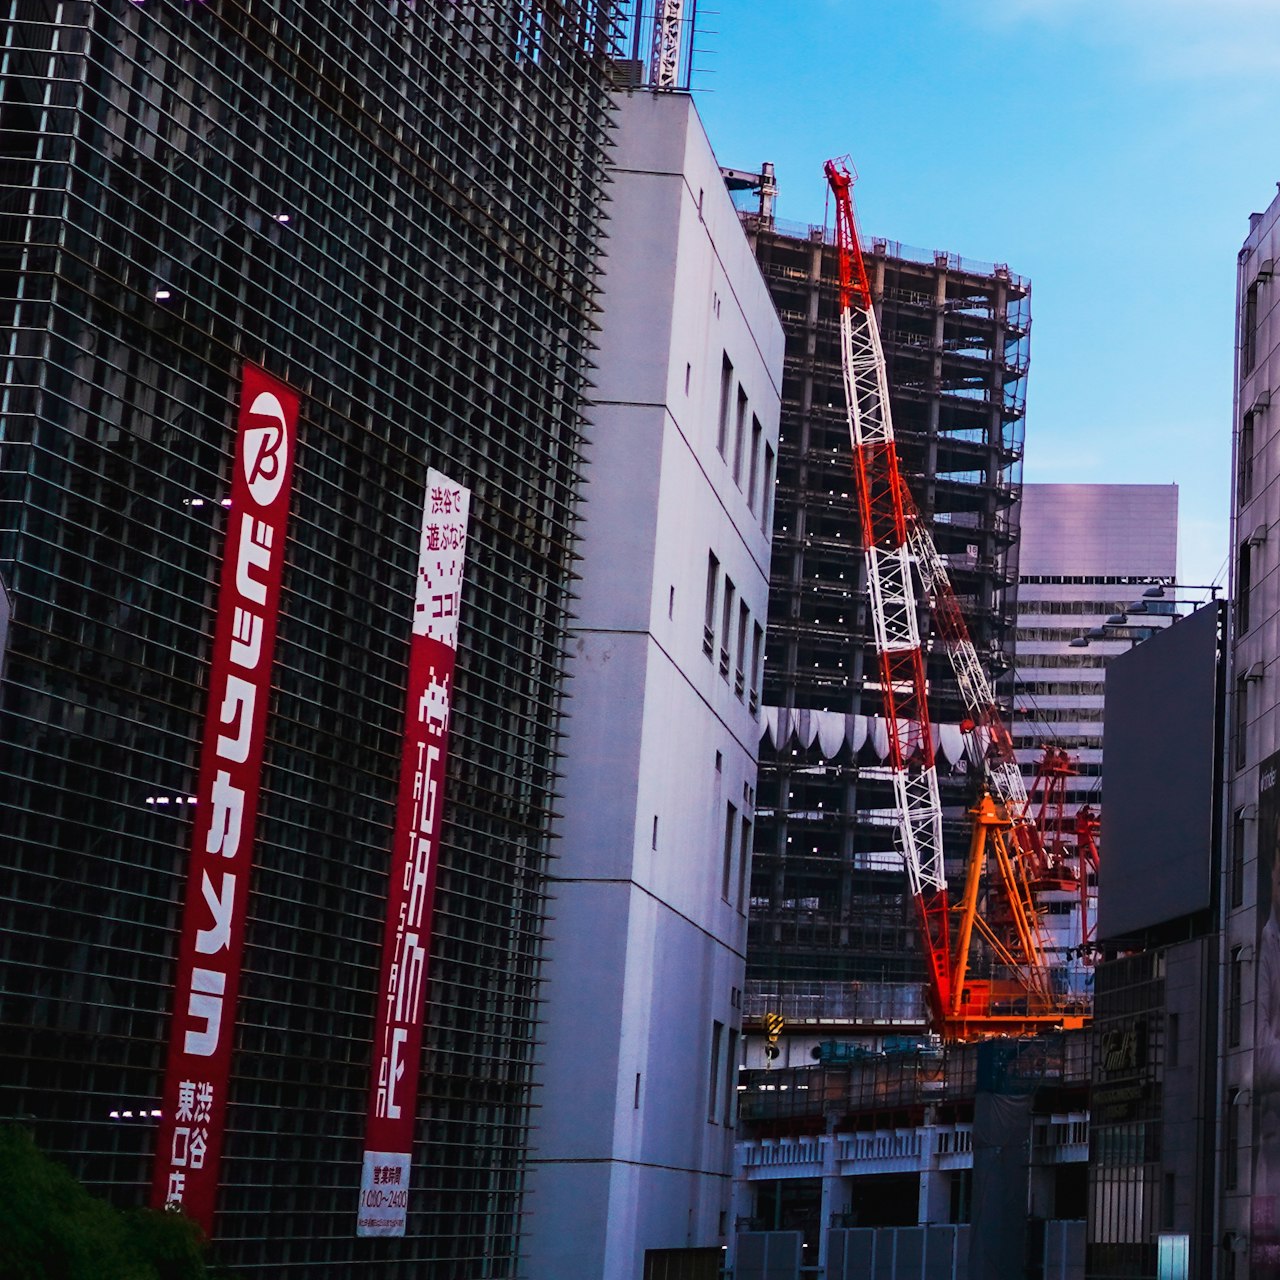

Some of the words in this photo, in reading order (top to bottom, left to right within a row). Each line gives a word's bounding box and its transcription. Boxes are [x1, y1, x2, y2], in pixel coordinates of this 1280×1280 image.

[426, 522, 465, 552] 遊ぶなら
[431, 486, 461, 515] 渋谷で
[183, 511, 275, 1057] ビックカメラ
[403, 741, 426, 892] TAITO
[376, 902, 408, 1119] STATION
[164, 1078, 197, 1214] 東口店
[189, 1081, 214, 1170] 渋谷
[373, 1166, 402, 1185] 営業時間
